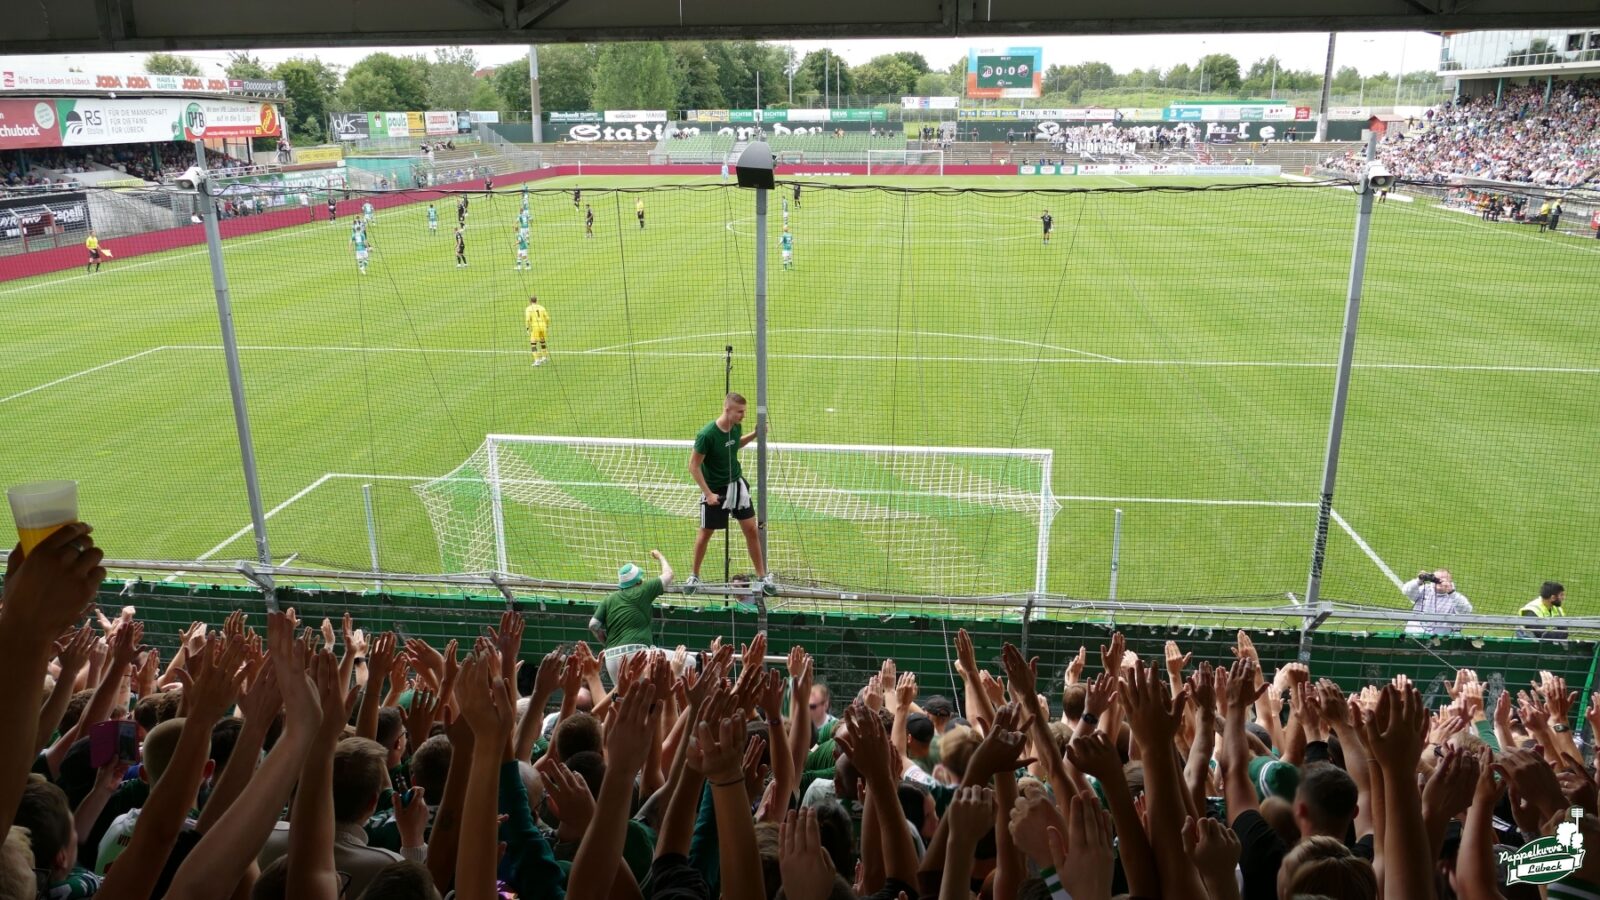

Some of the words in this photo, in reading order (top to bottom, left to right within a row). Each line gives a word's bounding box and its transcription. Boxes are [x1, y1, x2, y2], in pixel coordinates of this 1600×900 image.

[996, 67, 1003, 76] 0
[1008, 67, 1015, 76] 0
[95, 75, 122, 88] JODA
[126, 76, 151, 88] JODA
[182, 79, 204, 90] JODA
[207, 79, 228, 90] JODA
[131, 108, 168, 116] MANNSCHAFT
[536, 309, 540, 318] 1
